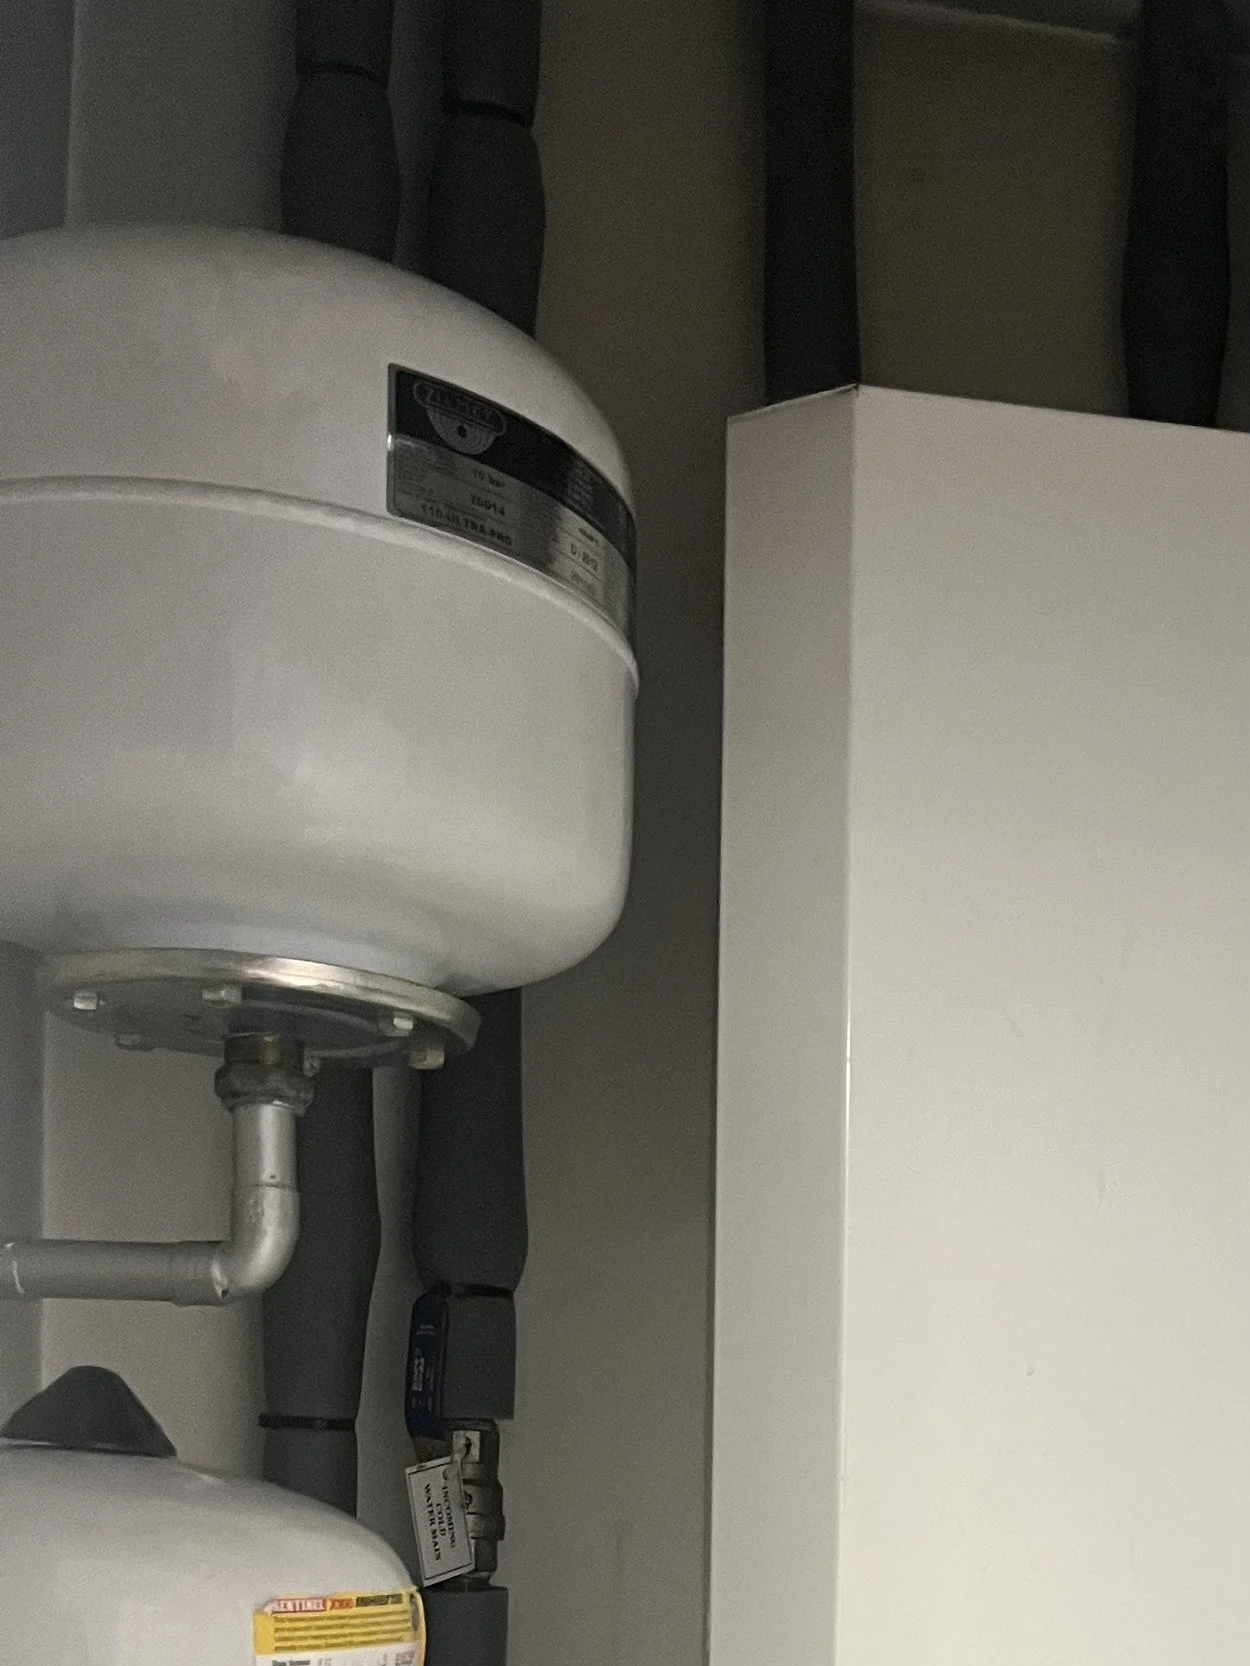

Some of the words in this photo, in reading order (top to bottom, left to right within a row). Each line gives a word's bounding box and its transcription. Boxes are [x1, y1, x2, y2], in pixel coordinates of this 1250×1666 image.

[423, 1483, 436, 1528] WATER
[430, 1528, 442, 1562] MAIN
[435, 1503, 447, 1537] COLD
[441, 1486, 457, 1549] INCOMING
